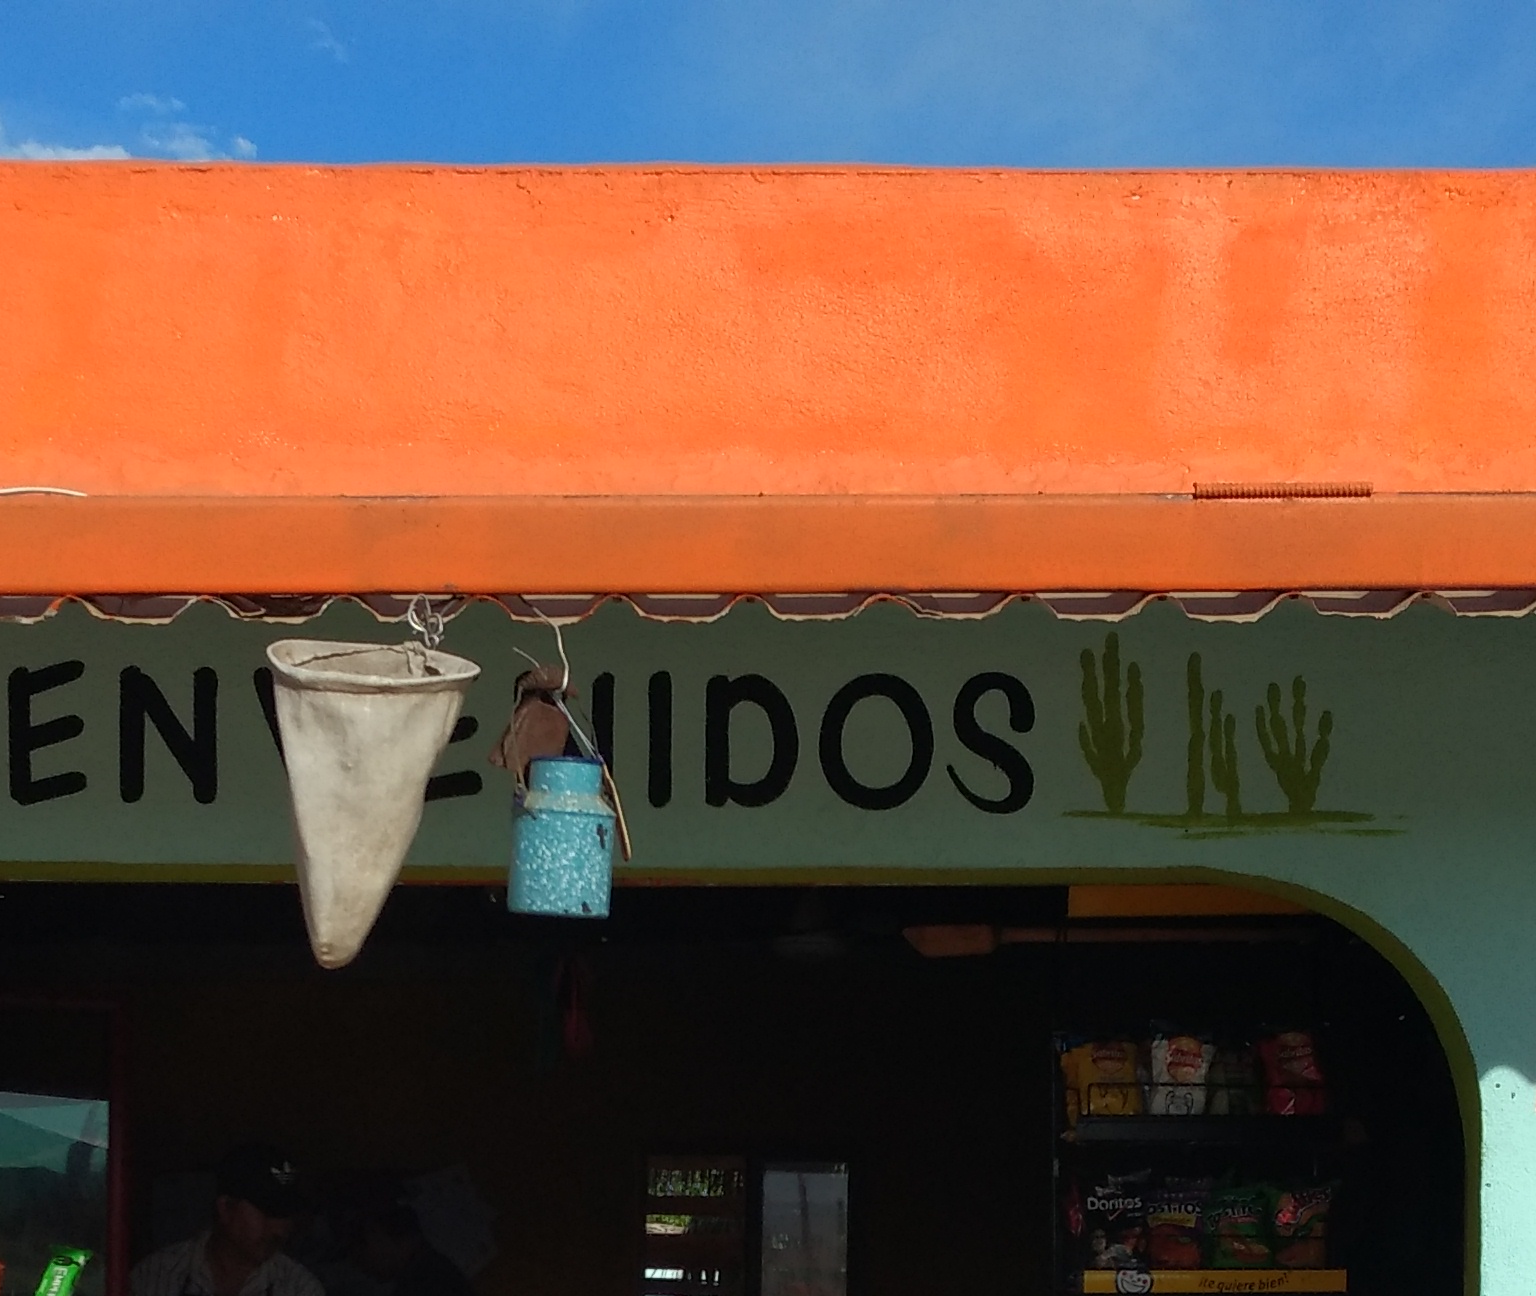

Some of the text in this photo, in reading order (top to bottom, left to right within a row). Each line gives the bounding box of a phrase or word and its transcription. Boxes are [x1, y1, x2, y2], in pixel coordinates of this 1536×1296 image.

[1087, 1196, 1143, 1211] Doritos
[1217, 1280, 1256, 1293] quiere
[1259, 1272, 1289, 1289] bien!
